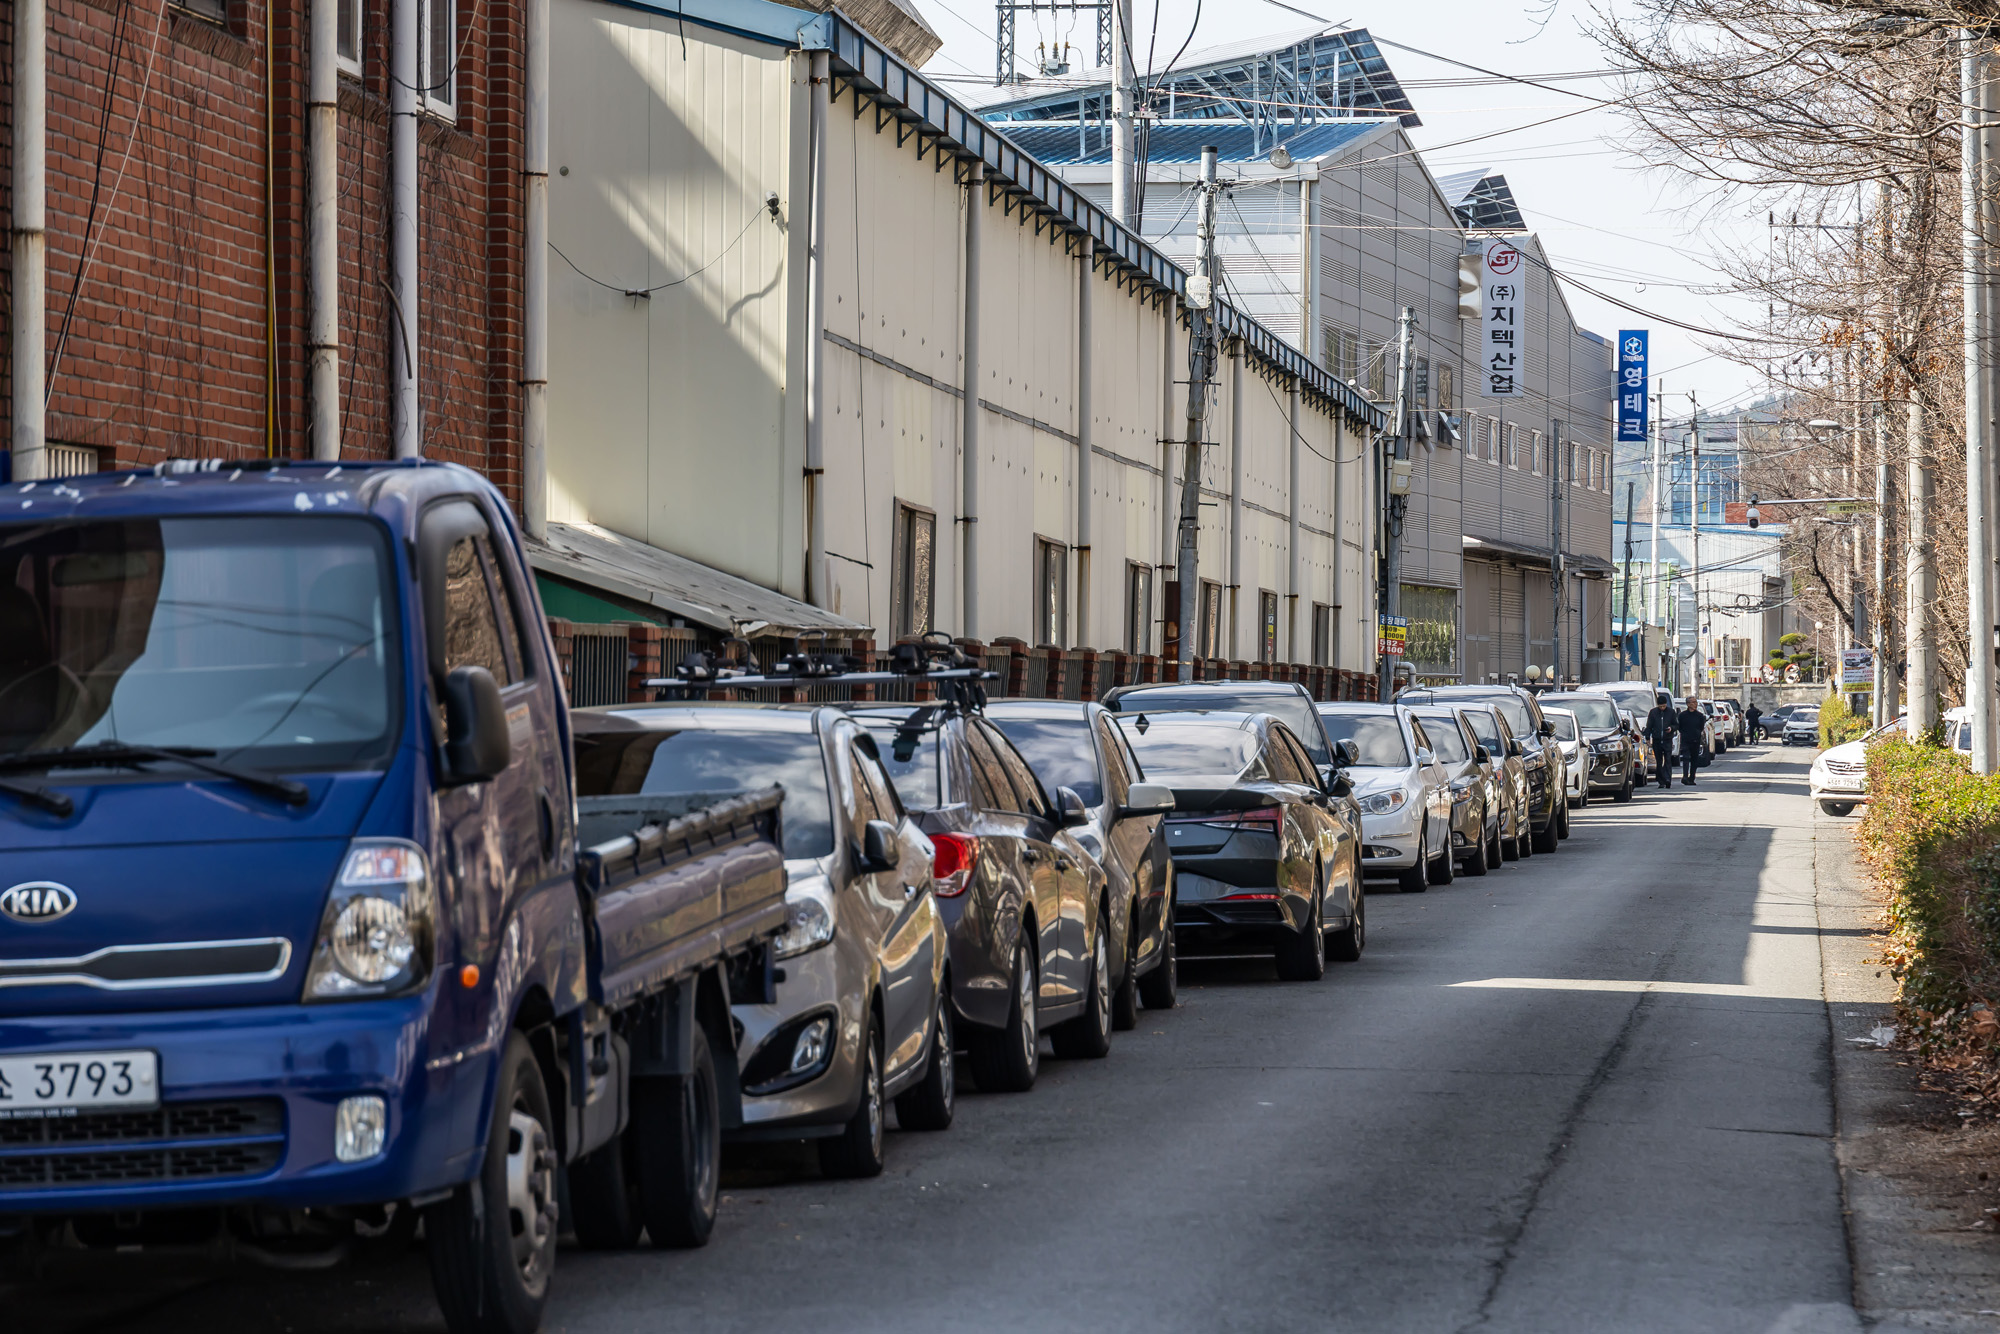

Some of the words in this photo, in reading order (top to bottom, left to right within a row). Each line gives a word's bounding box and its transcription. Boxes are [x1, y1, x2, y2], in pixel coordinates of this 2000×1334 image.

[1623, 366, 1643, 435] 영테크
[10, 890, 63, 915] KIA
[34, 1060, 134, 1100] 3793
